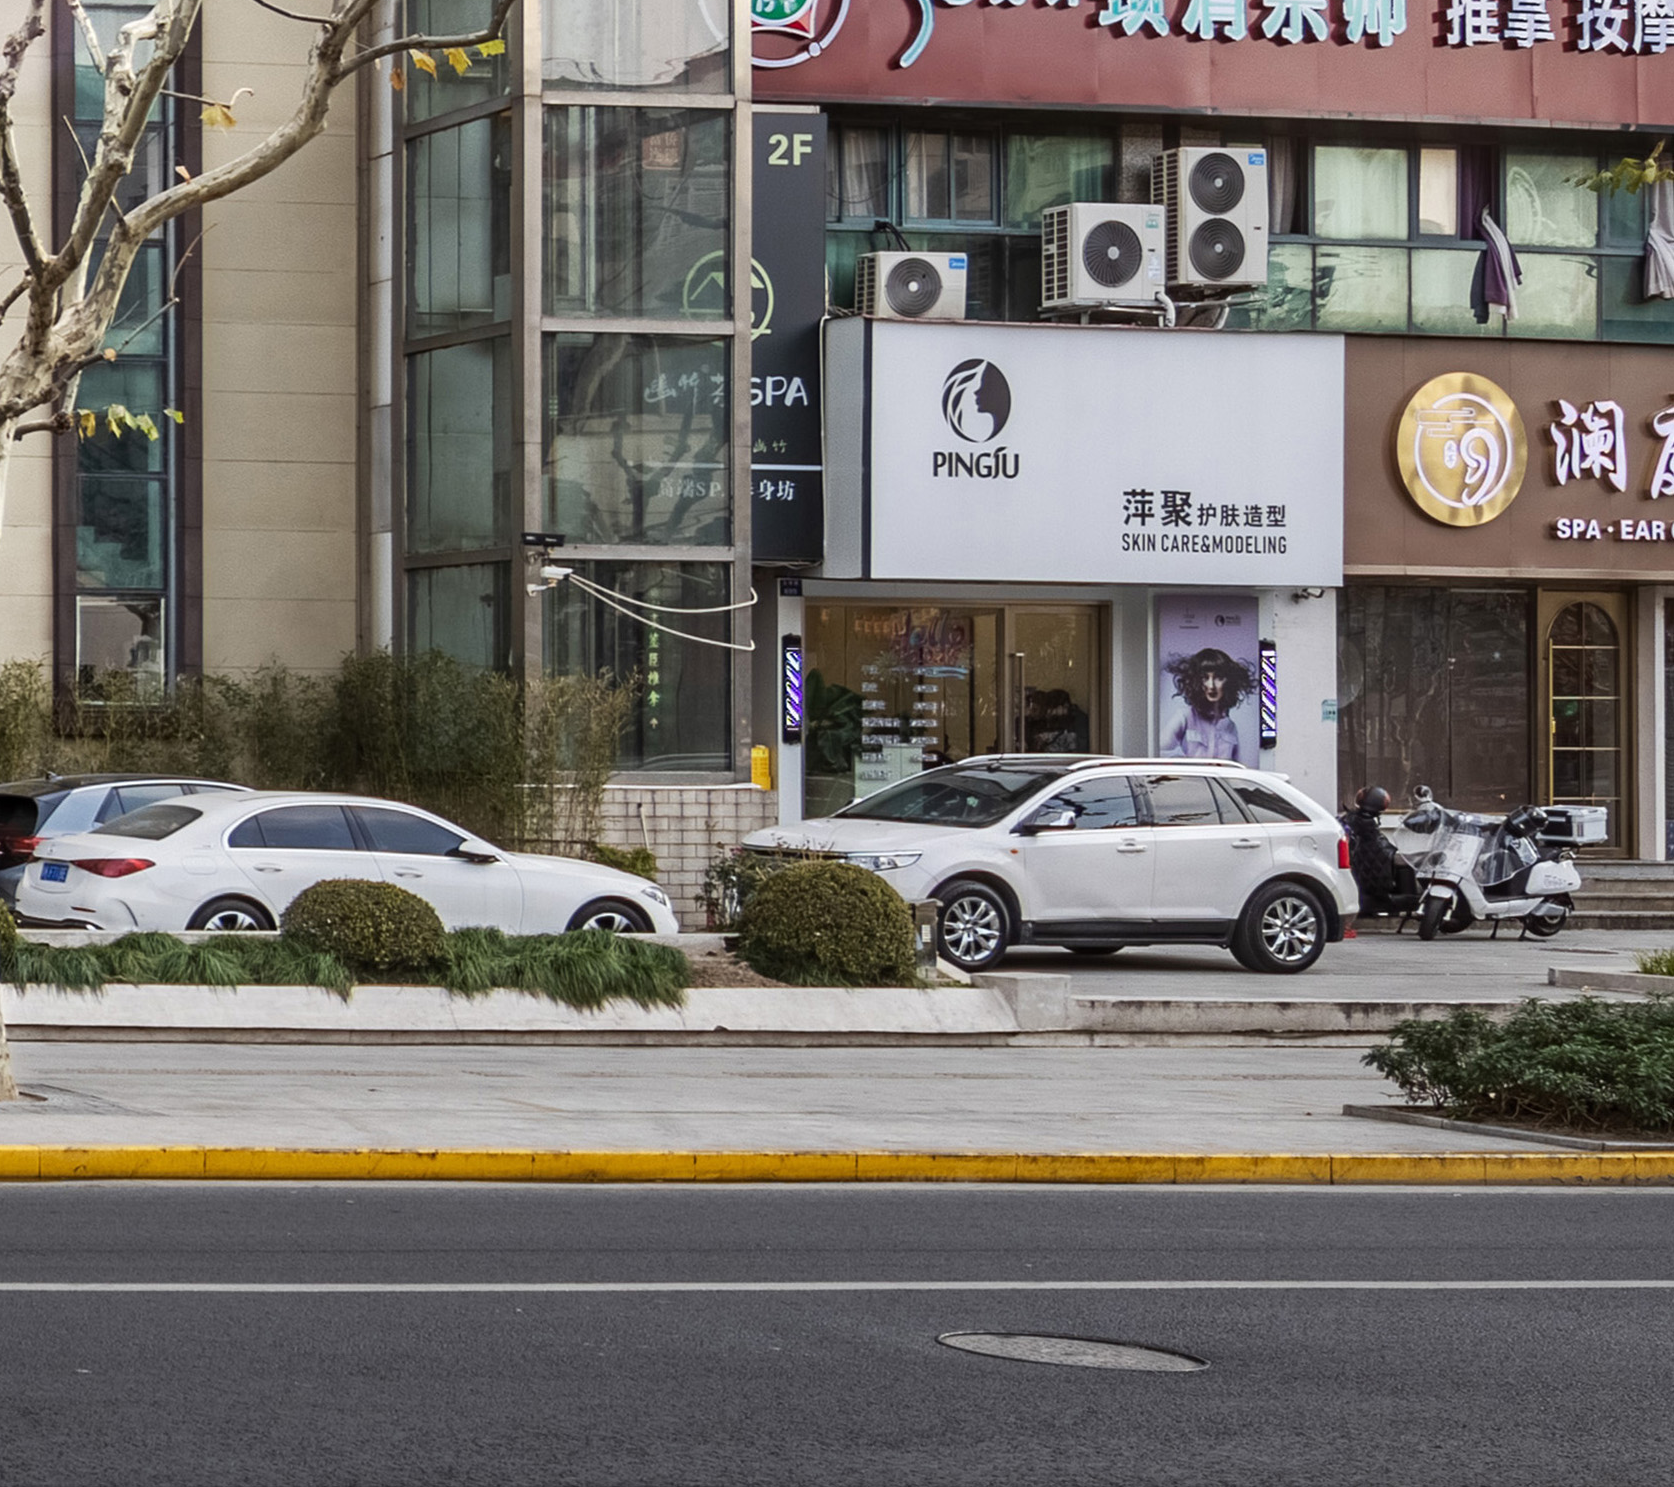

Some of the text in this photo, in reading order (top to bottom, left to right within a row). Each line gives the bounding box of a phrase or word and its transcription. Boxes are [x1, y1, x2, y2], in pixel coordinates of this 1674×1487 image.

[768, 133, 813, 166] 2F
[1557, 517, 1666, 541] SPA EAR
[1122, 533, 1287, 555] SKIN CARE&MODELING
